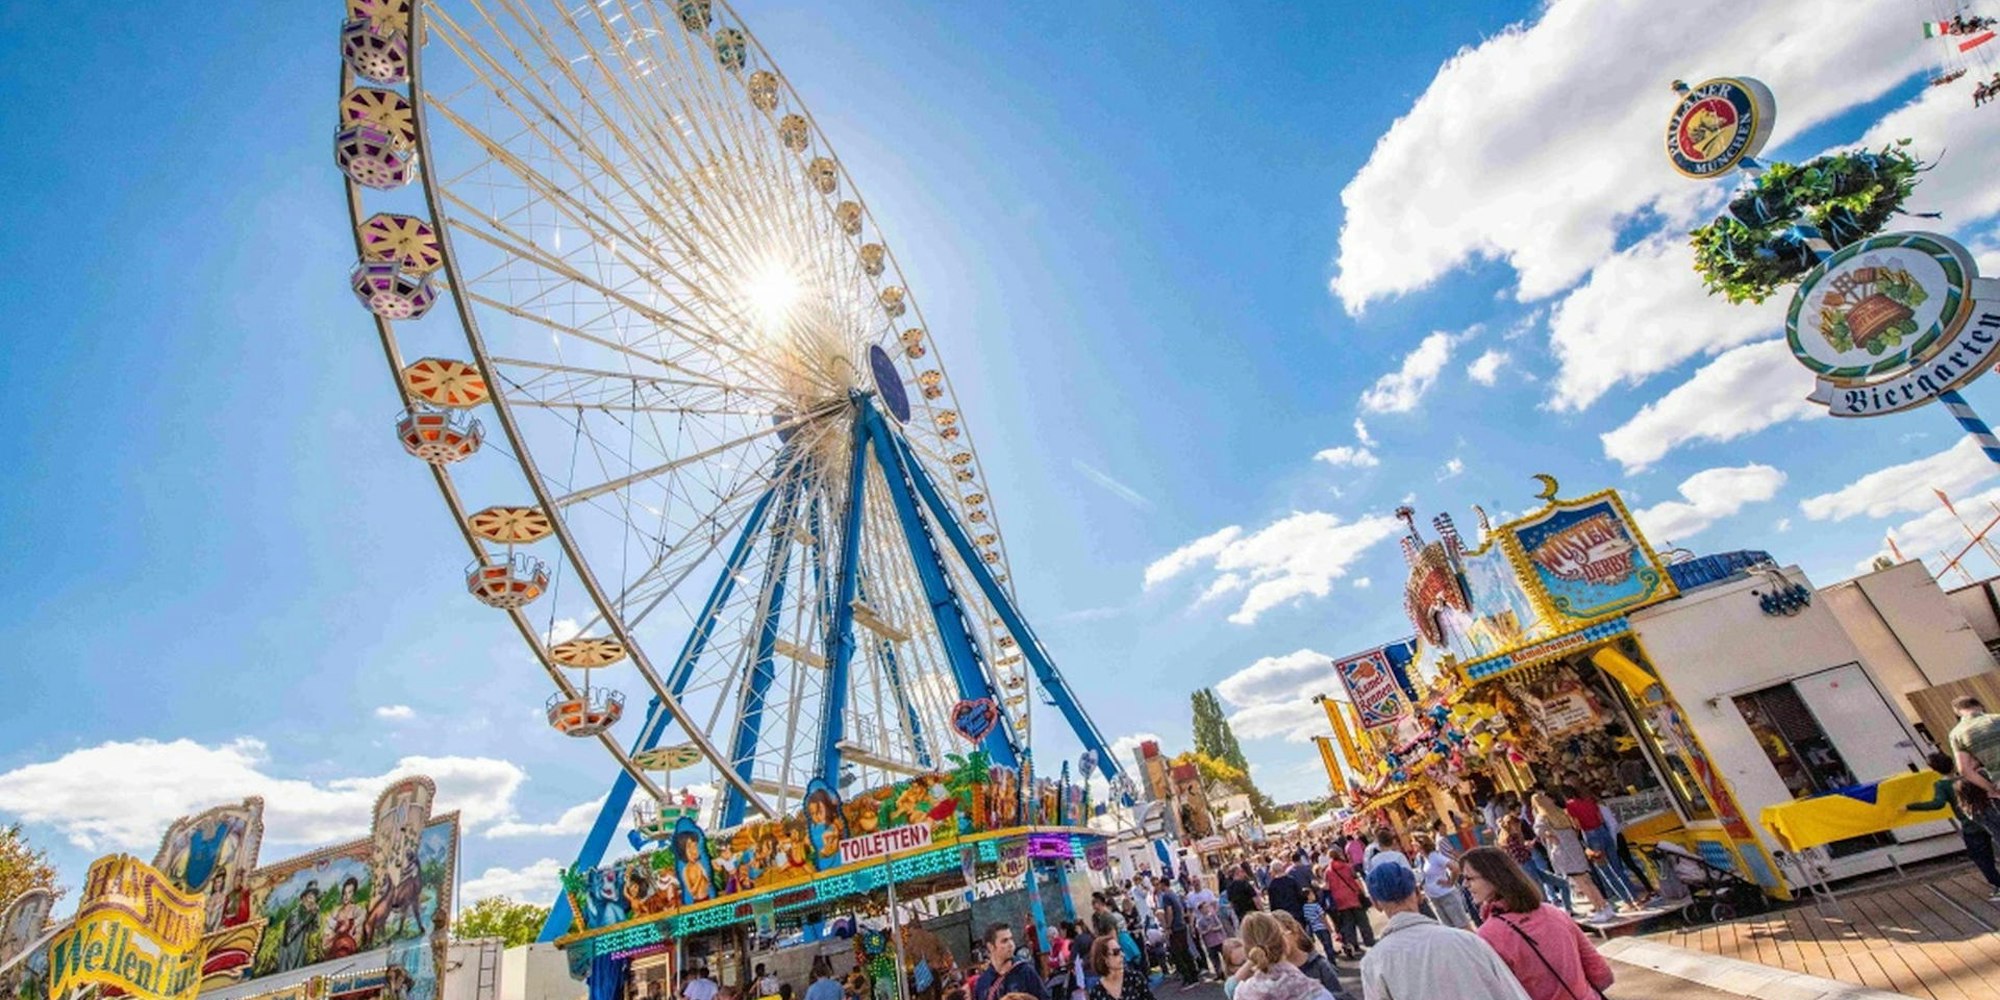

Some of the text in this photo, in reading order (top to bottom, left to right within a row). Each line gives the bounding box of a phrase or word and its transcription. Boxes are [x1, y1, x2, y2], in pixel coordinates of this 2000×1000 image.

[1669, 84, 1731, 156] PAULANER
[1845, 313, 2000, 413] Biergarten
[1583, 552, 1628, 581] DERBY
[841, 825, 920, 861] TOILETTEN
